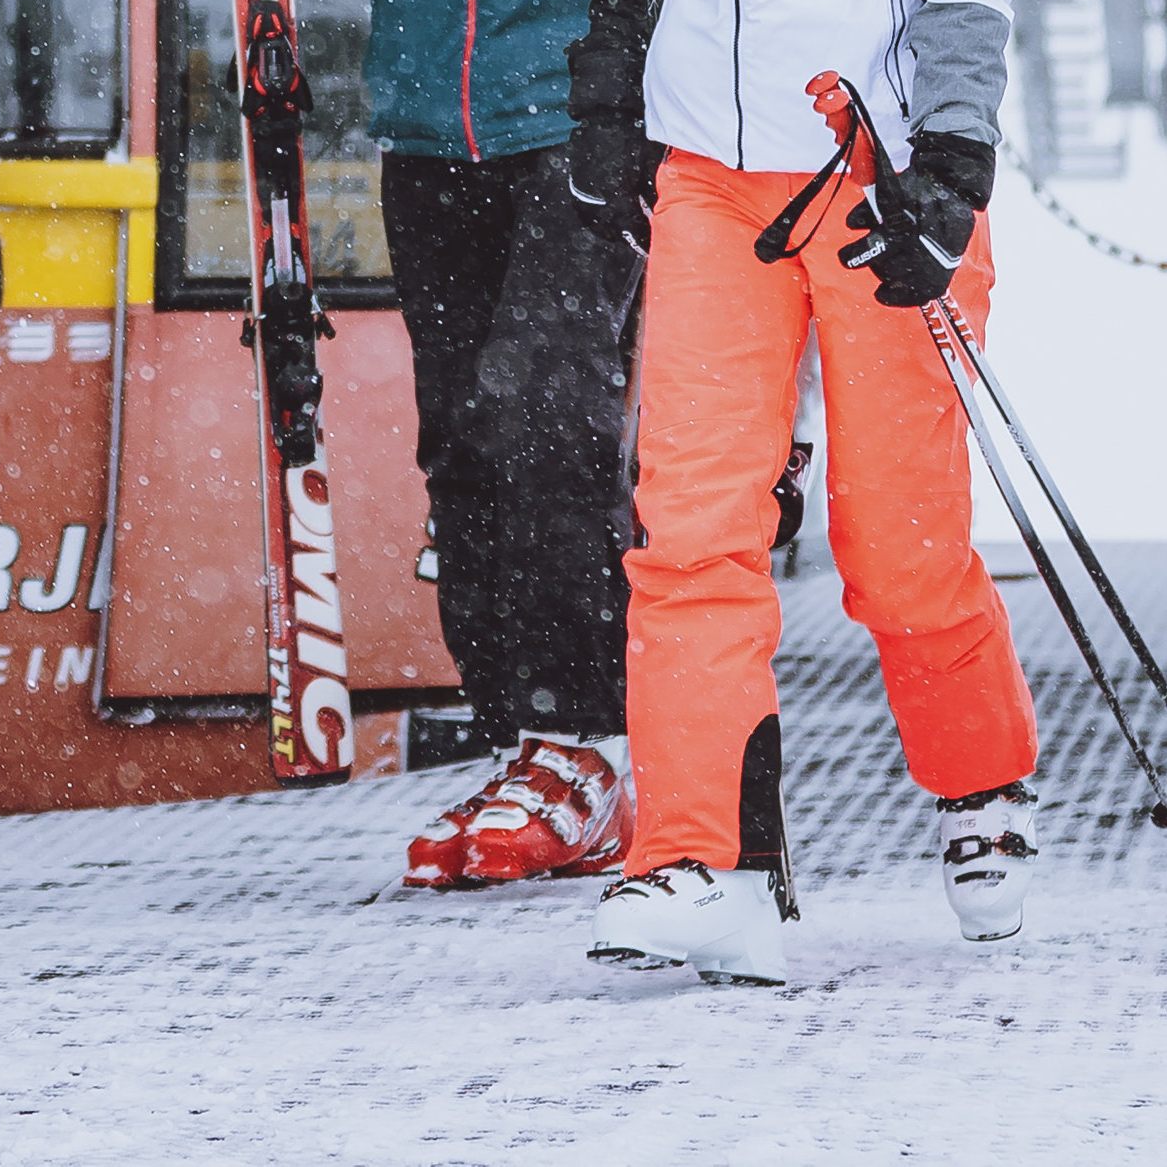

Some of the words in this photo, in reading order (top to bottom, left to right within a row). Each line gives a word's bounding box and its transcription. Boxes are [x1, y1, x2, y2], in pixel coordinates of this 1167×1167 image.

[847, 240, 886, 268] reusch
[285, 457, 356, 769] OMIC
[268, 647, 293, 714] 174
[272, 714, 295, 765] LT
